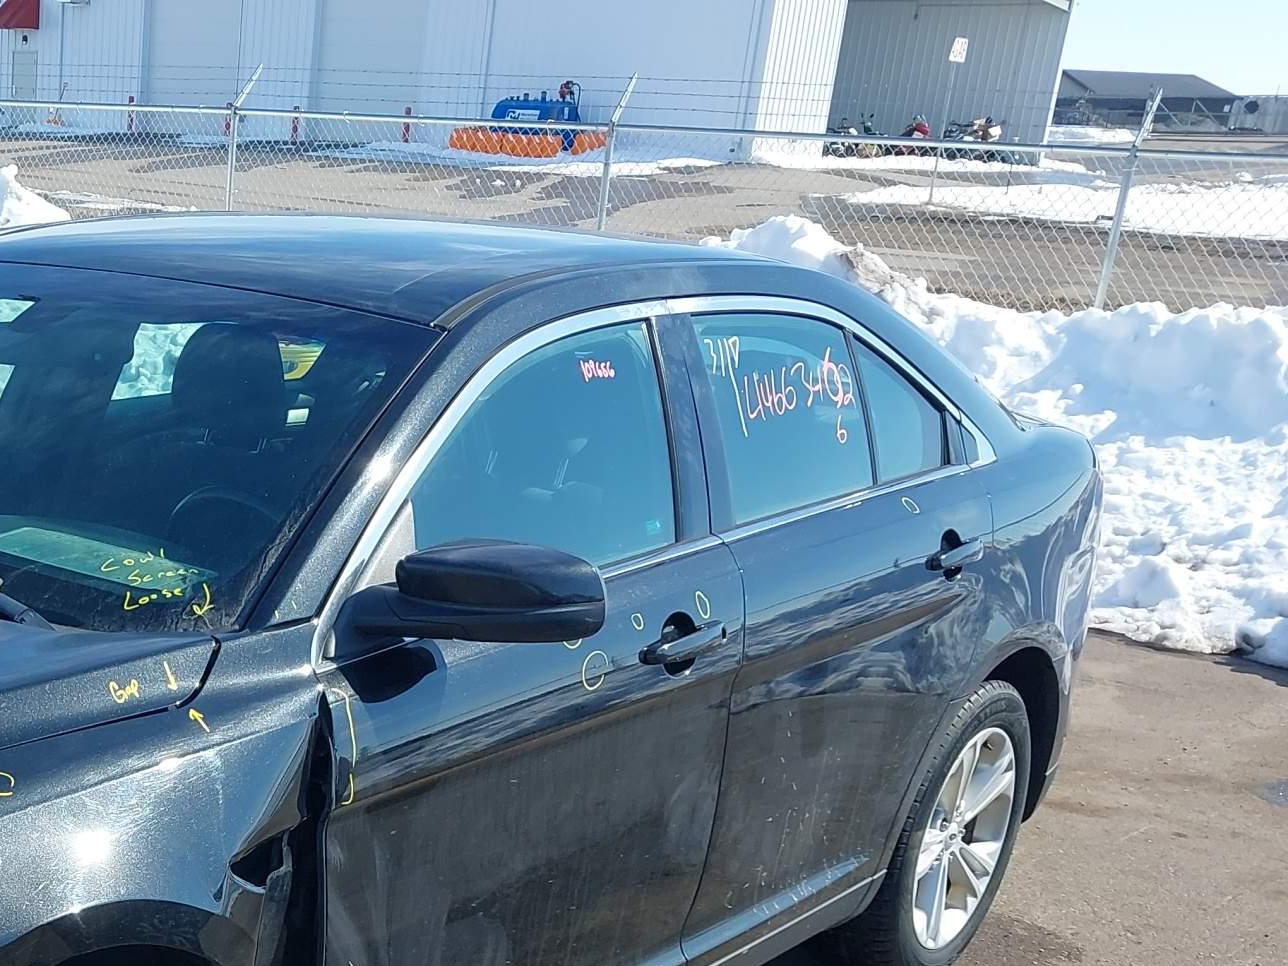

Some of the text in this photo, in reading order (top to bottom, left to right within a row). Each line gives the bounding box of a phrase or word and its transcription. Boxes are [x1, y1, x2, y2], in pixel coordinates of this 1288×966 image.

[836, 414, 848, 444] 6
[100, 547, 165, 572] Cowl
[127, 569, 199, 586] Screen
[123, 590, 184, 610] Loose
